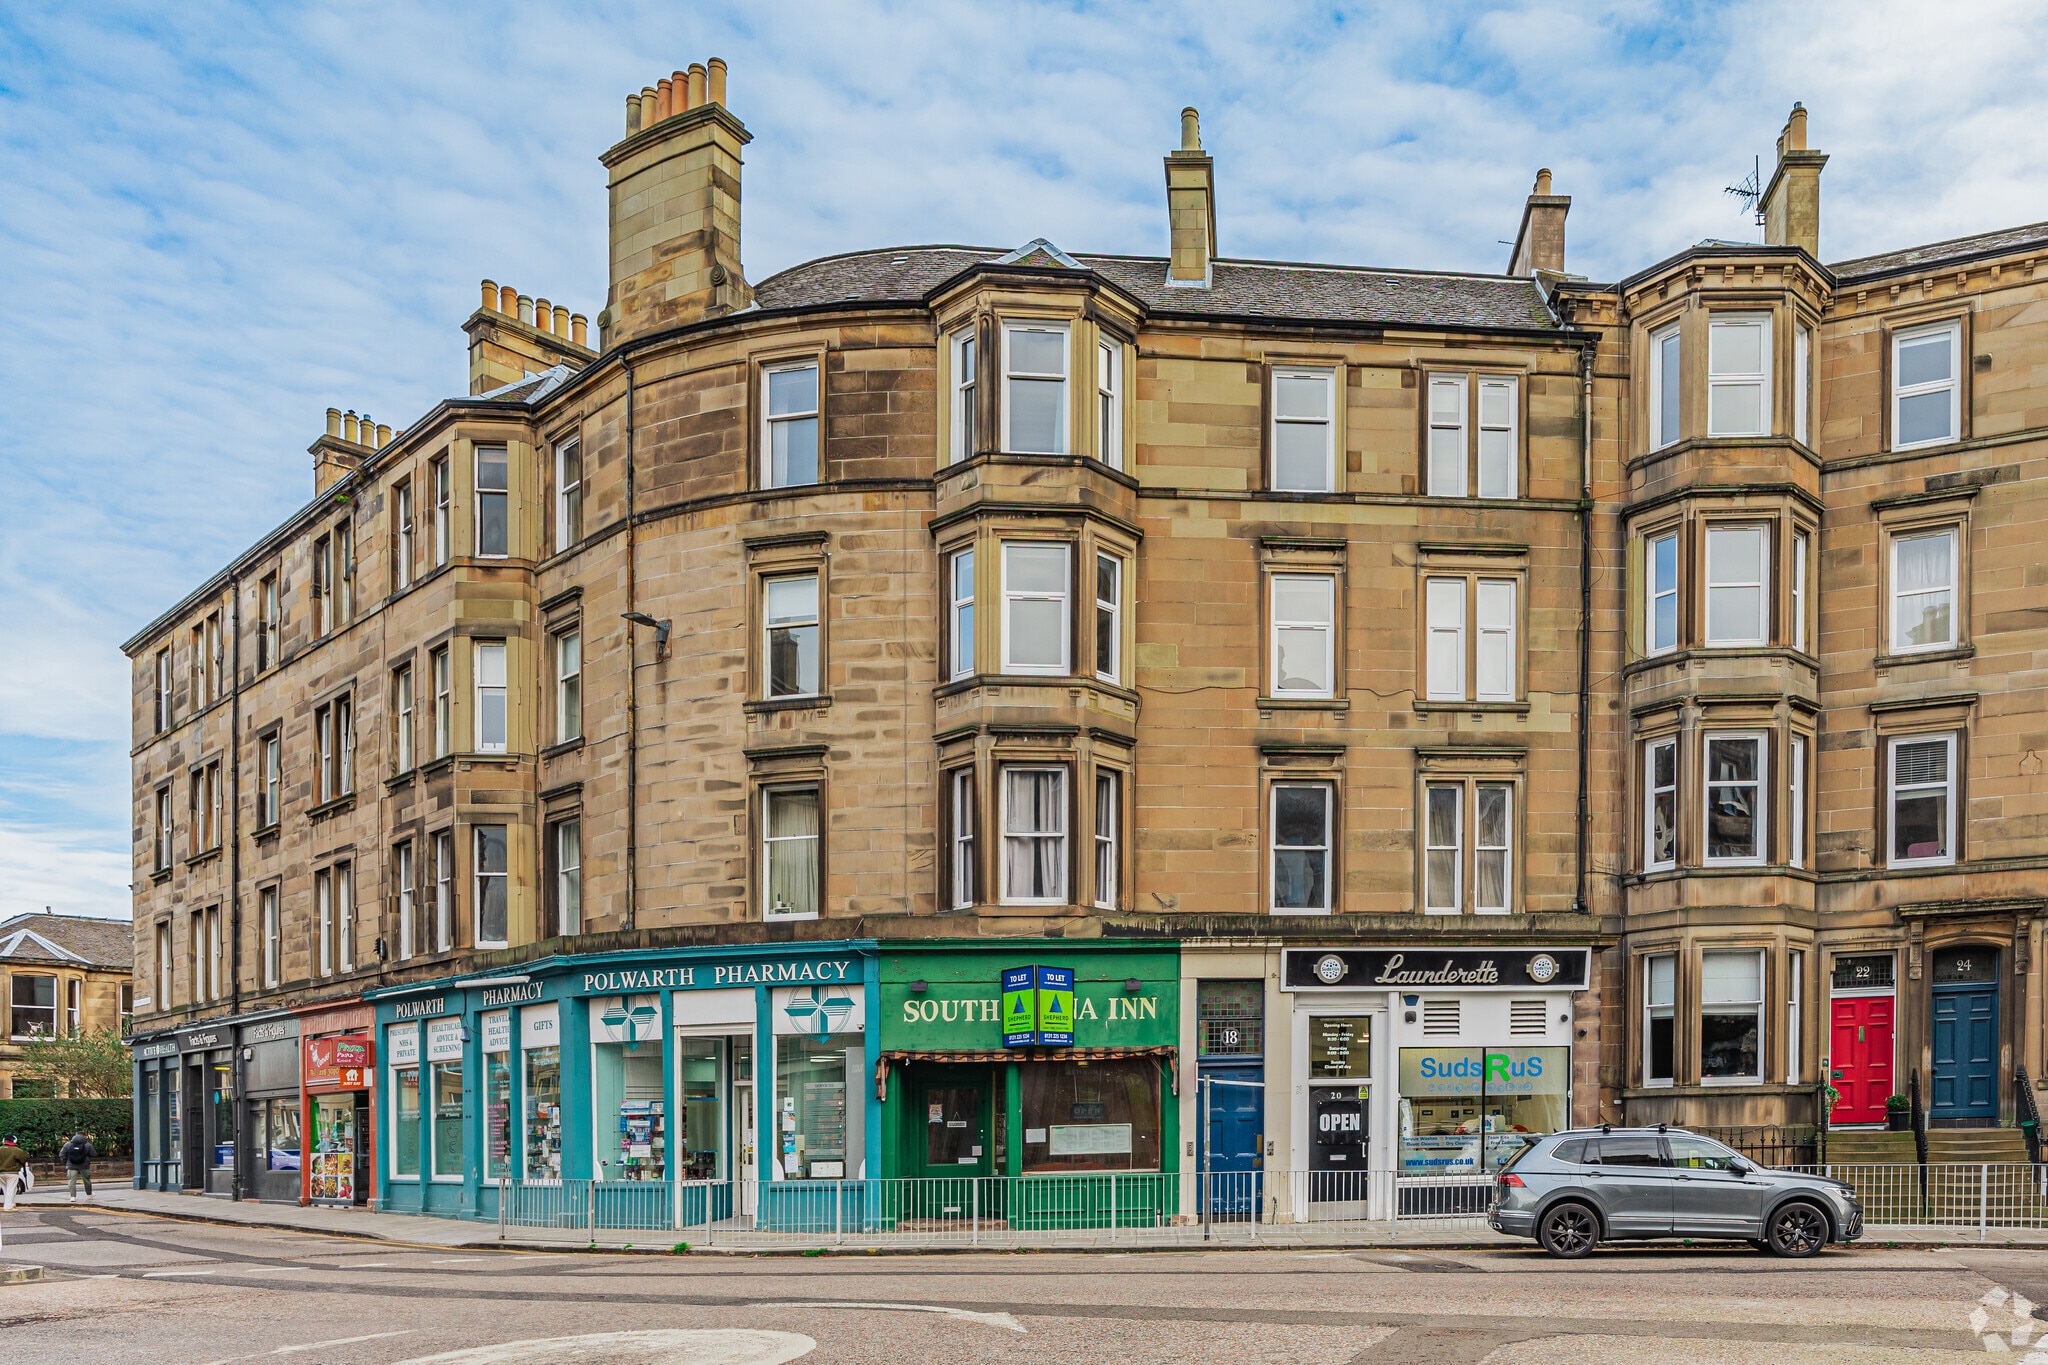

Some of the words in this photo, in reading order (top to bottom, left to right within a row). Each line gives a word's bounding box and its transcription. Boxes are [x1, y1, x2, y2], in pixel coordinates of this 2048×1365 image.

[1375, 954, 1499, 984] Launderette
[1956, 959, 1972, 972] 24
[583, 968, 695, 992] POLWARTH
[714, 961, 851, 984] PHARMACY
[1856, 966, 1870, 978] 22
[1010, 975, 1017, 983] TO
[1018, 973, 1027, 982] LET
[1046, 973, 1055, 981] TO
[1055, 974, 1065, 982] LET
[396, 998, 444, 1018] POLWARTH
[483, 982, 544, 1006] PHARMACY
[903, 999, 1001, 1023] SOUTH
[1108, 996, 1157, 1020] INN
[488, 1014, 509, 1024] TRAVEL
[1007, 1014, 1031, 1022] SHEPHERD
[431, 1022, 461, 1032] HEALTHCAR
[533, 1019, 553, 1031] GIFTS
[269, 1024, 285, 1039] Figures
[390, 1027, 418, 1037] PRESCRIPTIO
[436, 1034, 454, 1042] ADVICE
[489, 1037, 508, 1046] ADVICE
[1225, 1030, 1238, 1044] 18
[143, 1046, 156, 1056] ACTIVE
[160, 1043, 176, 1053] HEALTH
[337, 1042, 365, 1053] Pizza
[433, 1044, 462, 1053] SCREENING
[396, 1049, 416, 1058] PRIVATE
[1330, 1092, 1342, 1100] 20
[1319, 1113, 1360, 1131] OPEN
[1405, 1157, 1474, 1167] www.sudsrus.co.uk
